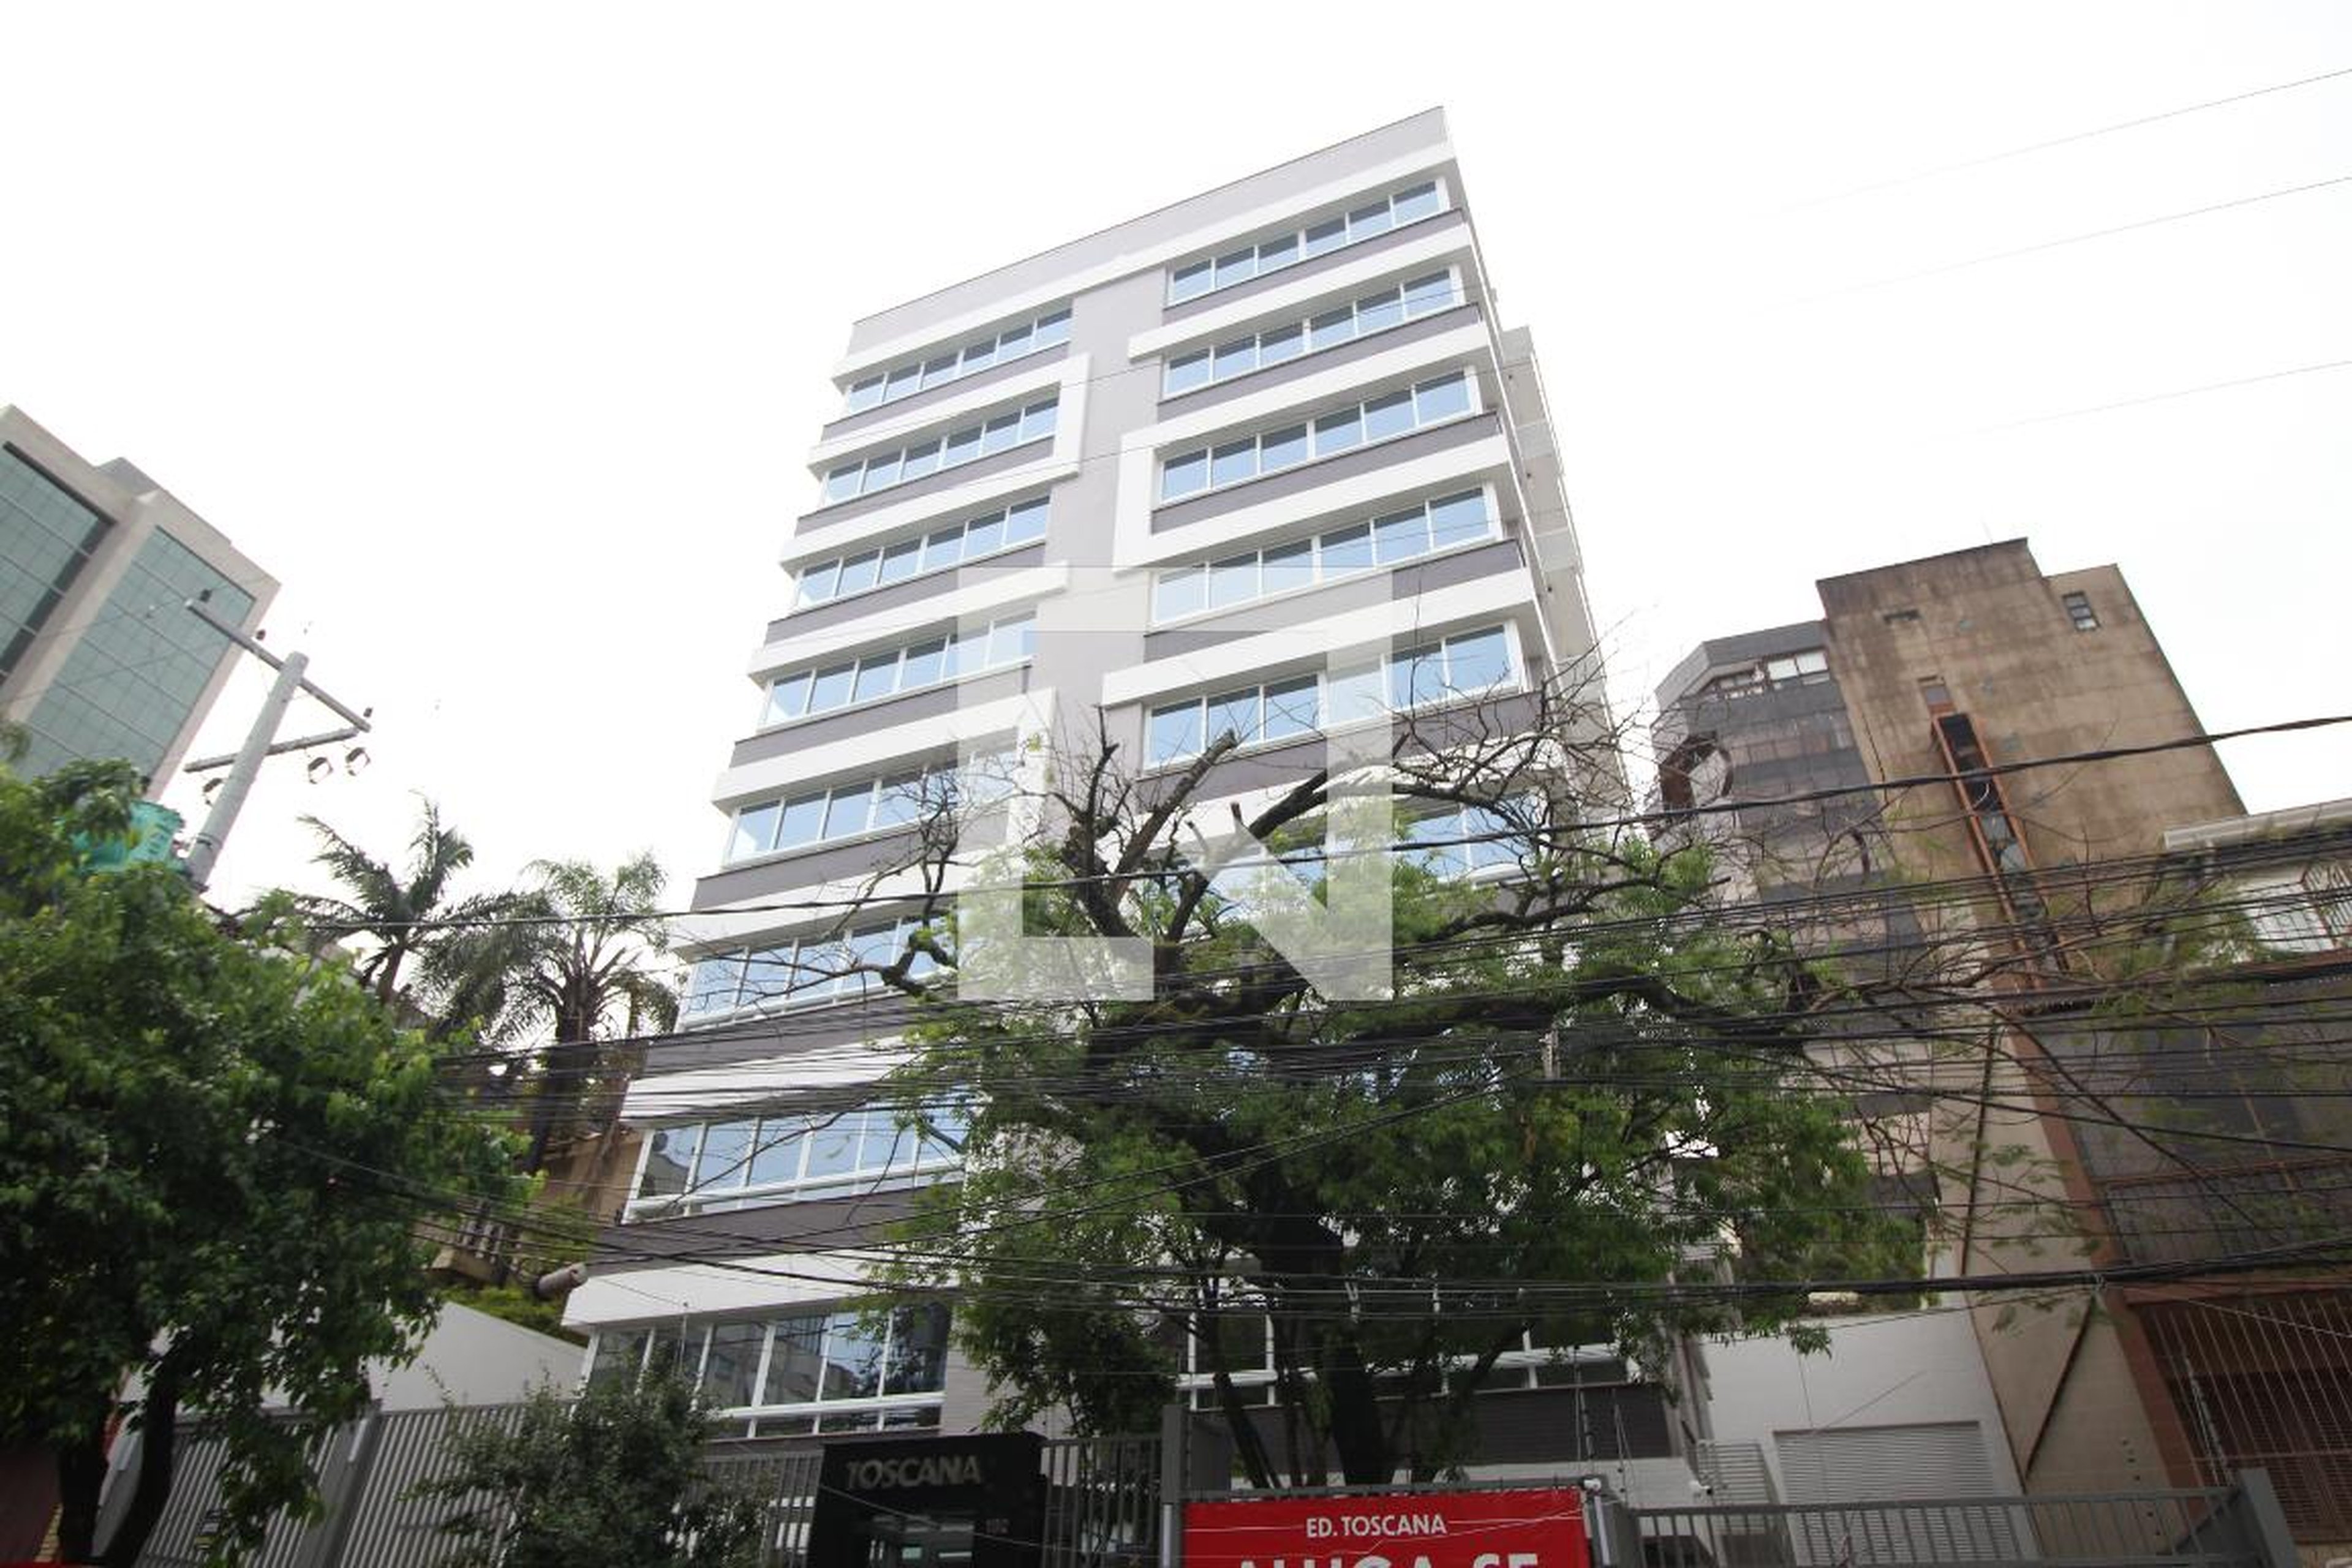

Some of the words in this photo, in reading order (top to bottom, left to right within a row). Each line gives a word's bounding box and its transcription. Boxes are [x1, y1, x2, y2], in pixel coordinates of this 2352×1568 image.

[845, 1455, 981, 1489] TOSCANA
[1306, 1517, 1338, 1537] ED.
[1341, 1514, 1448, 1537] TOSCANA
